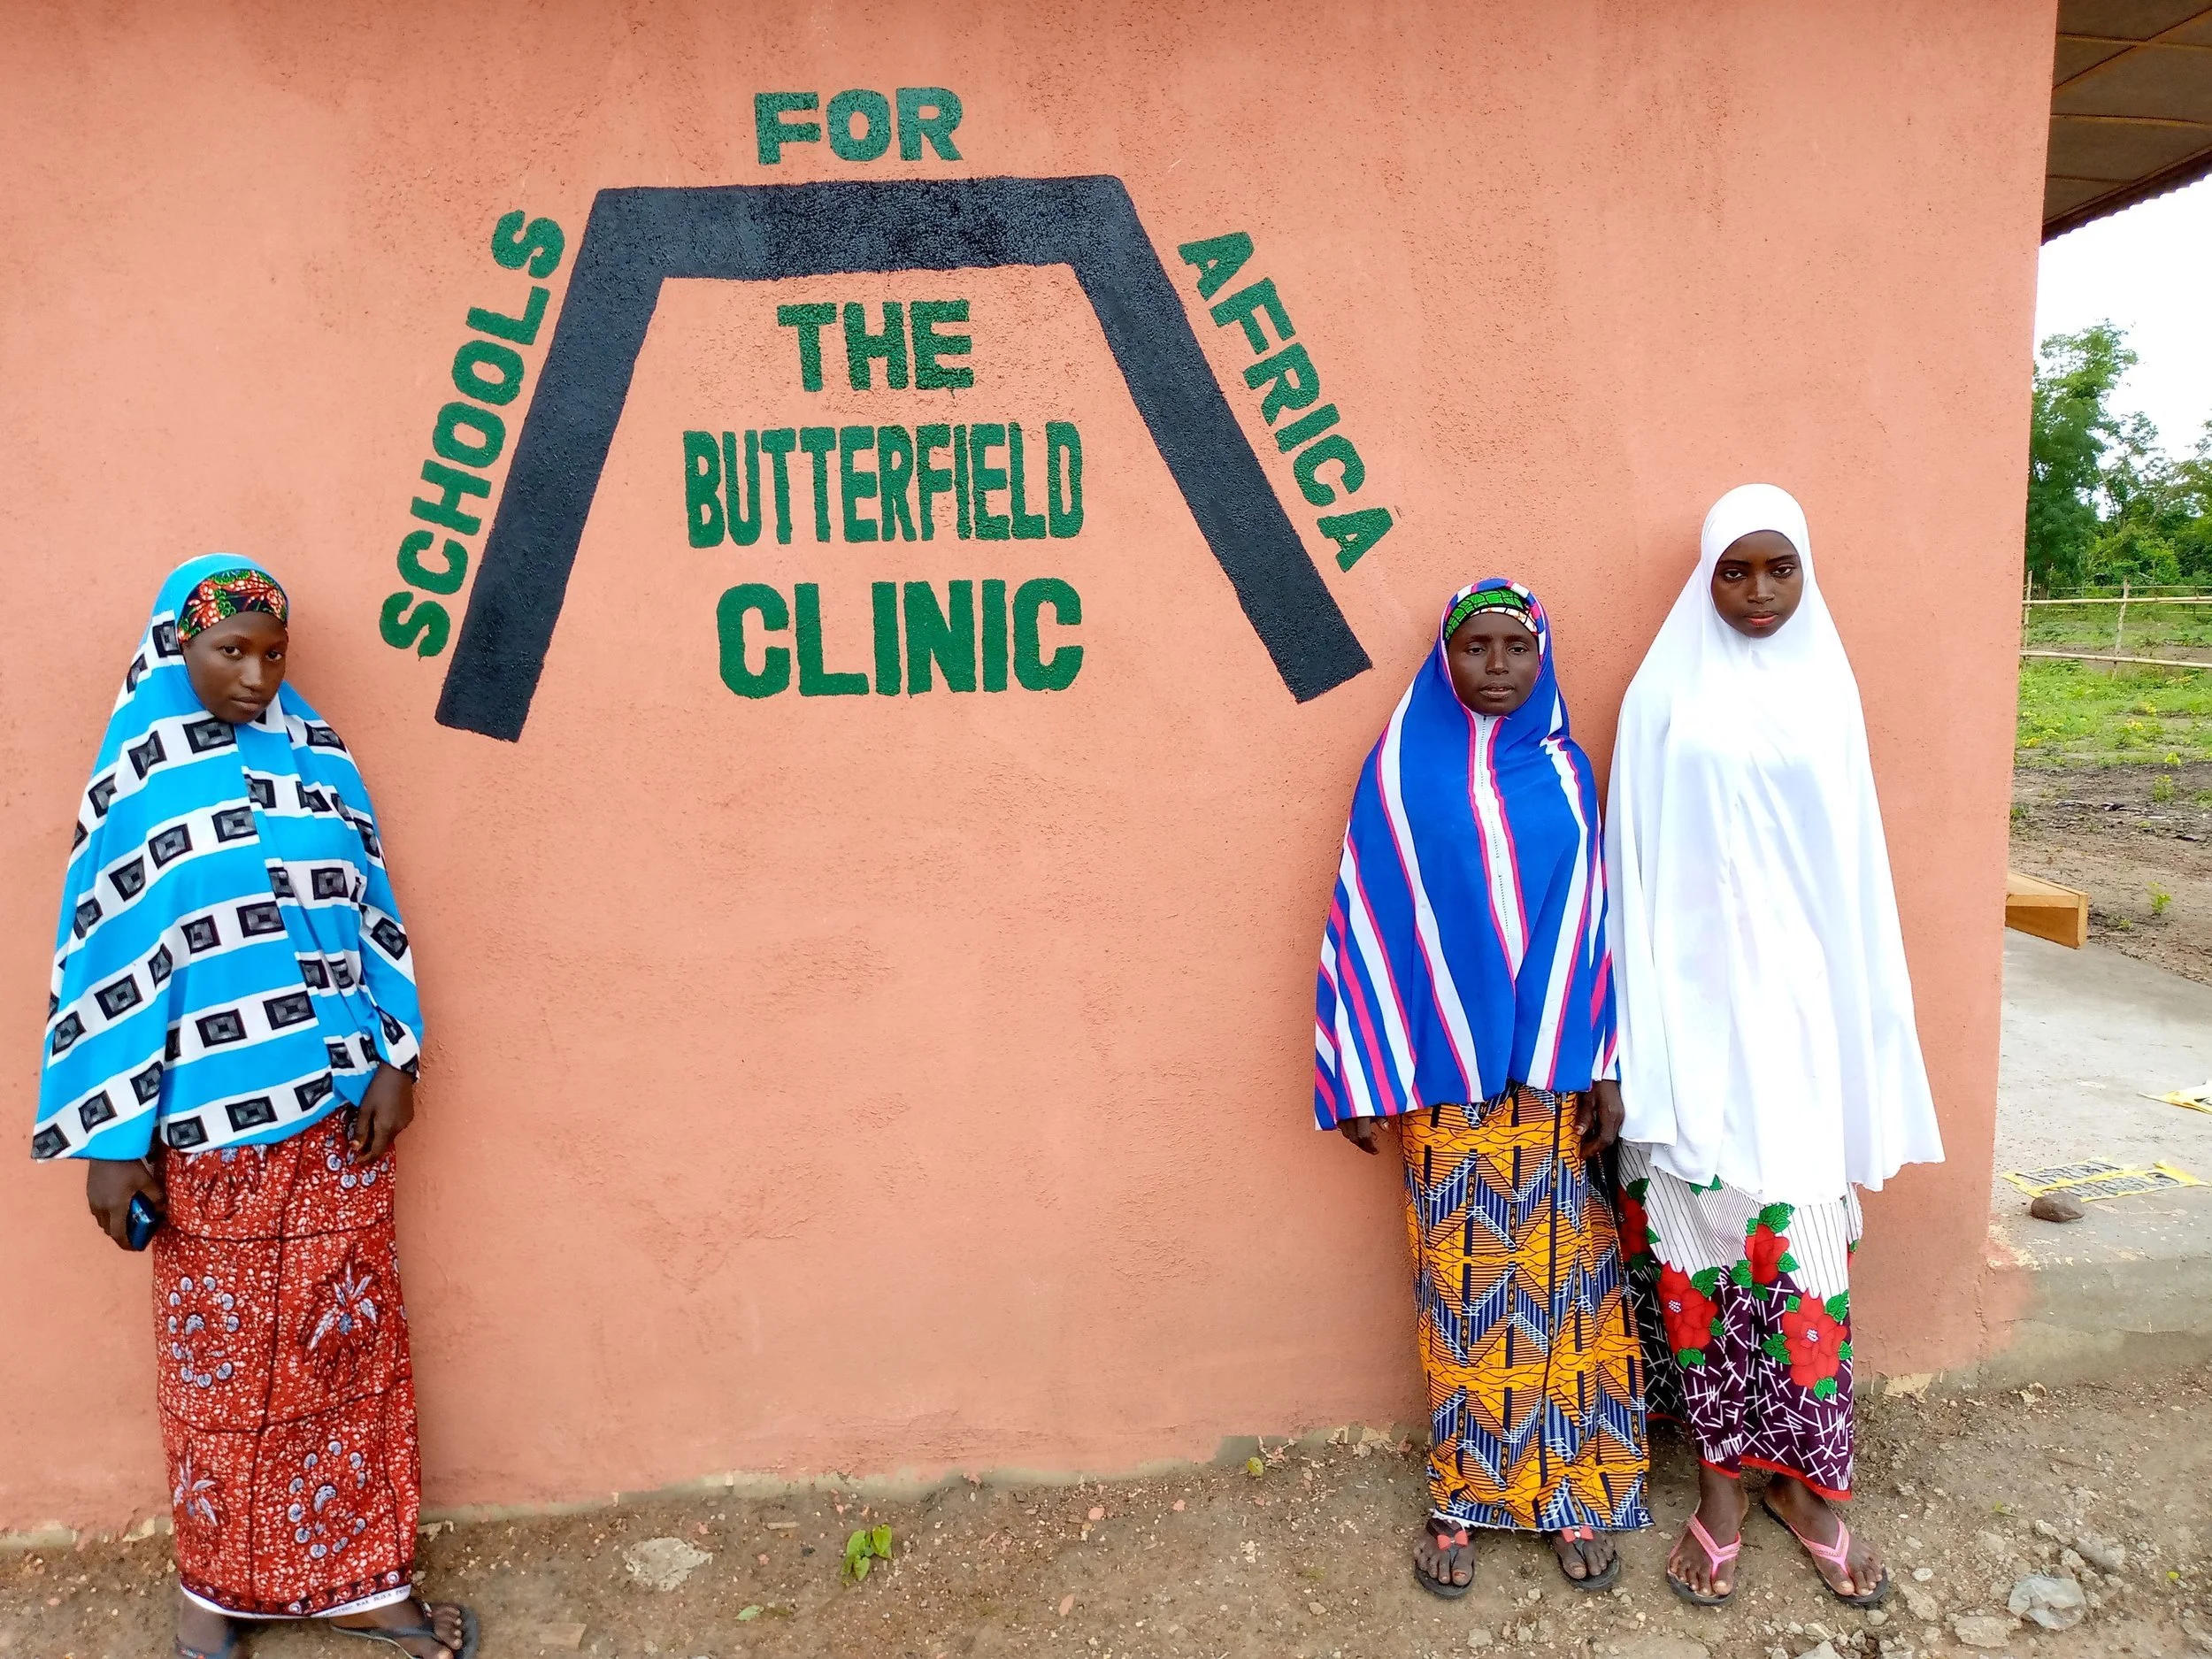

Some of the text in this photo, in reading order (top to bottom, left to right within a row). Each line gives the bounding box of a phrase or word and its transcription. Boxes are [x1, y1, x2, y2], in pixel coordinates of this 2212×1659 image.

[755, 87, 964, 165] FOR
[778, 299, 973, 392] THE
[1178, 232, 1394, 572] AFRICA
[380, 210, 565, 660] SCHOOLS
[683, 422, 1084, 549] BUTTERFIELD
[717, 578, 1084, 698] CLINIC
